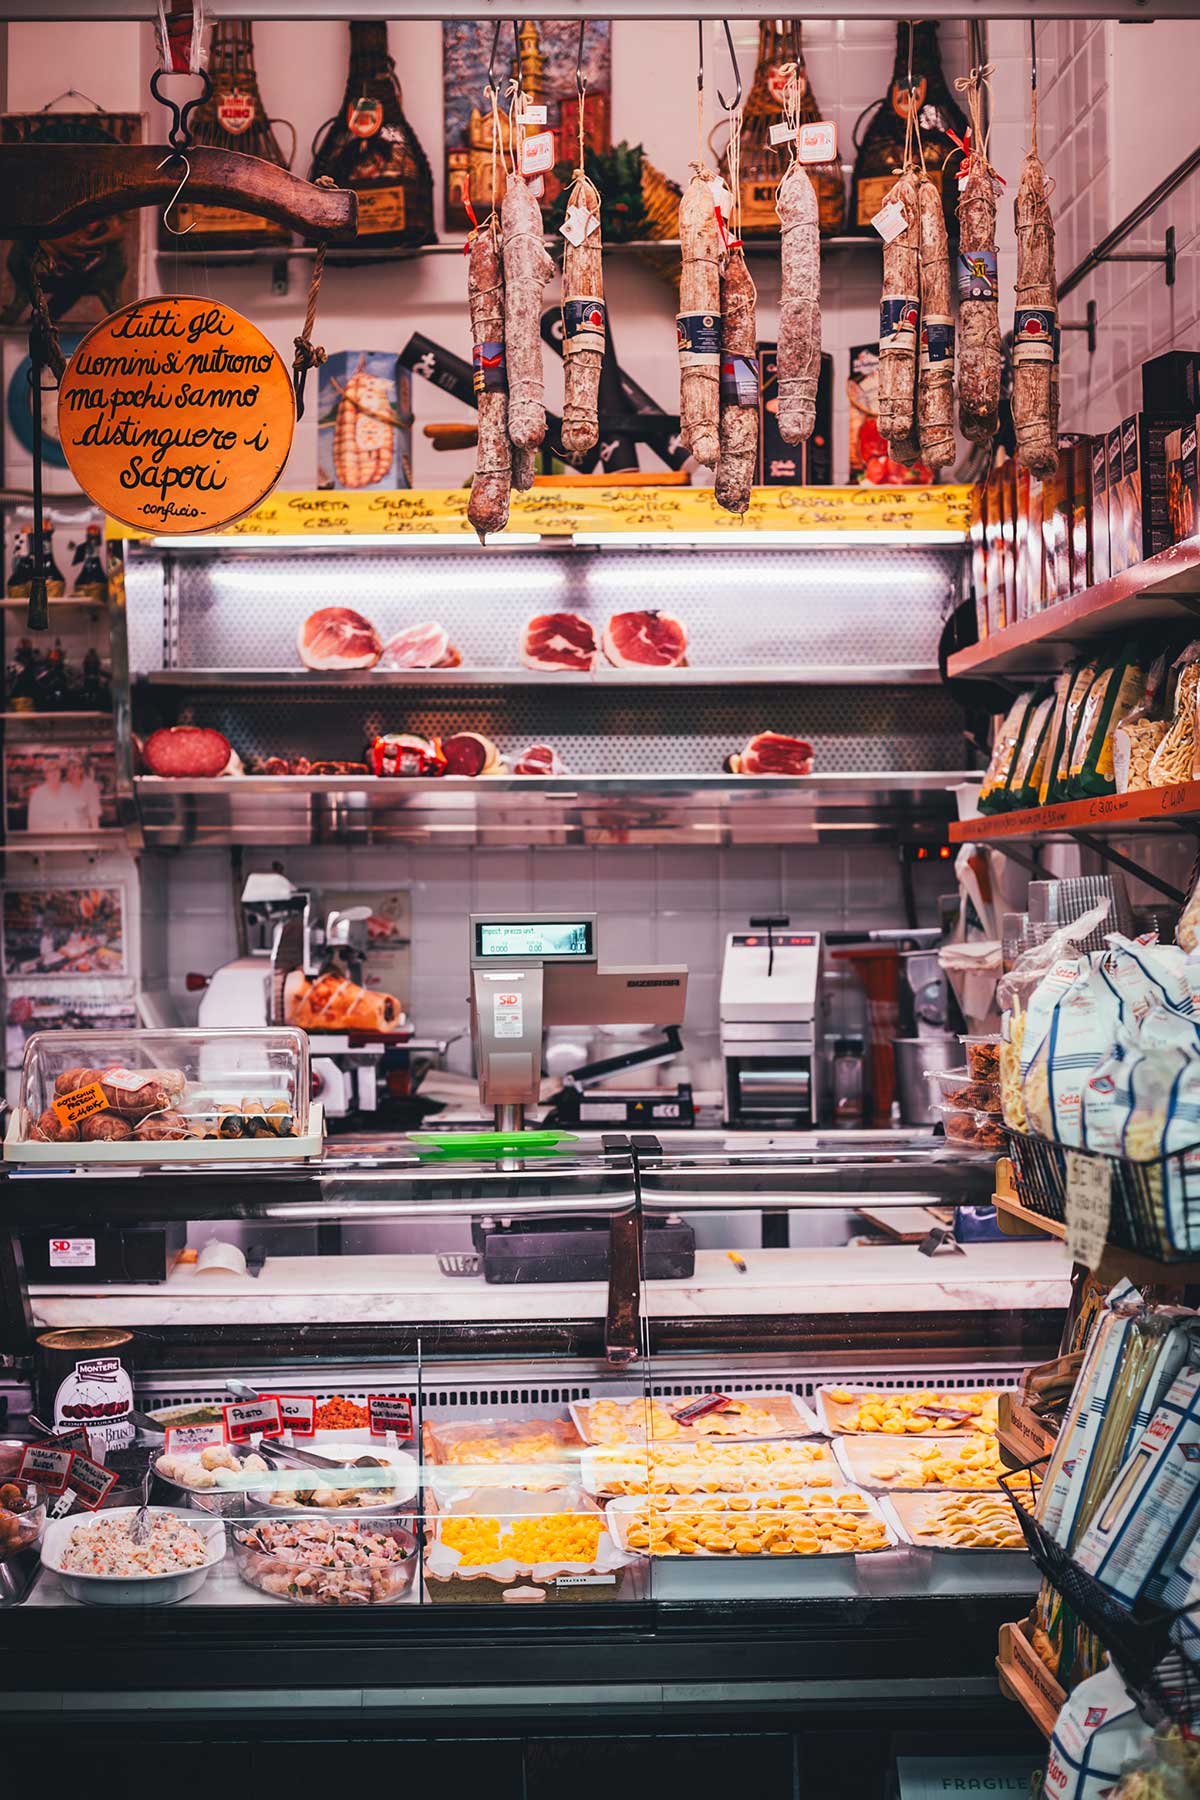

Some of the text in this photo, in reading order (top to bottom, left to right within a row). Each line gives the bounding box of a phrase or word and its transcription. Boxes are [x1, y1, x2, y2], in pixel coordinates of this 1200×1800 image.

[111, 309, 234, 343] tutti gli
[75, 345, 275, 377] uomini si nutrono
[65, 388, 111, 411] ma
[109, 381, 173, 420] pochi
[72, 412, 269, 463] distinguere i
[232, 1408, 264, 1421] PESTO
[942, 1776, 1028, 1791] FRAGILE
